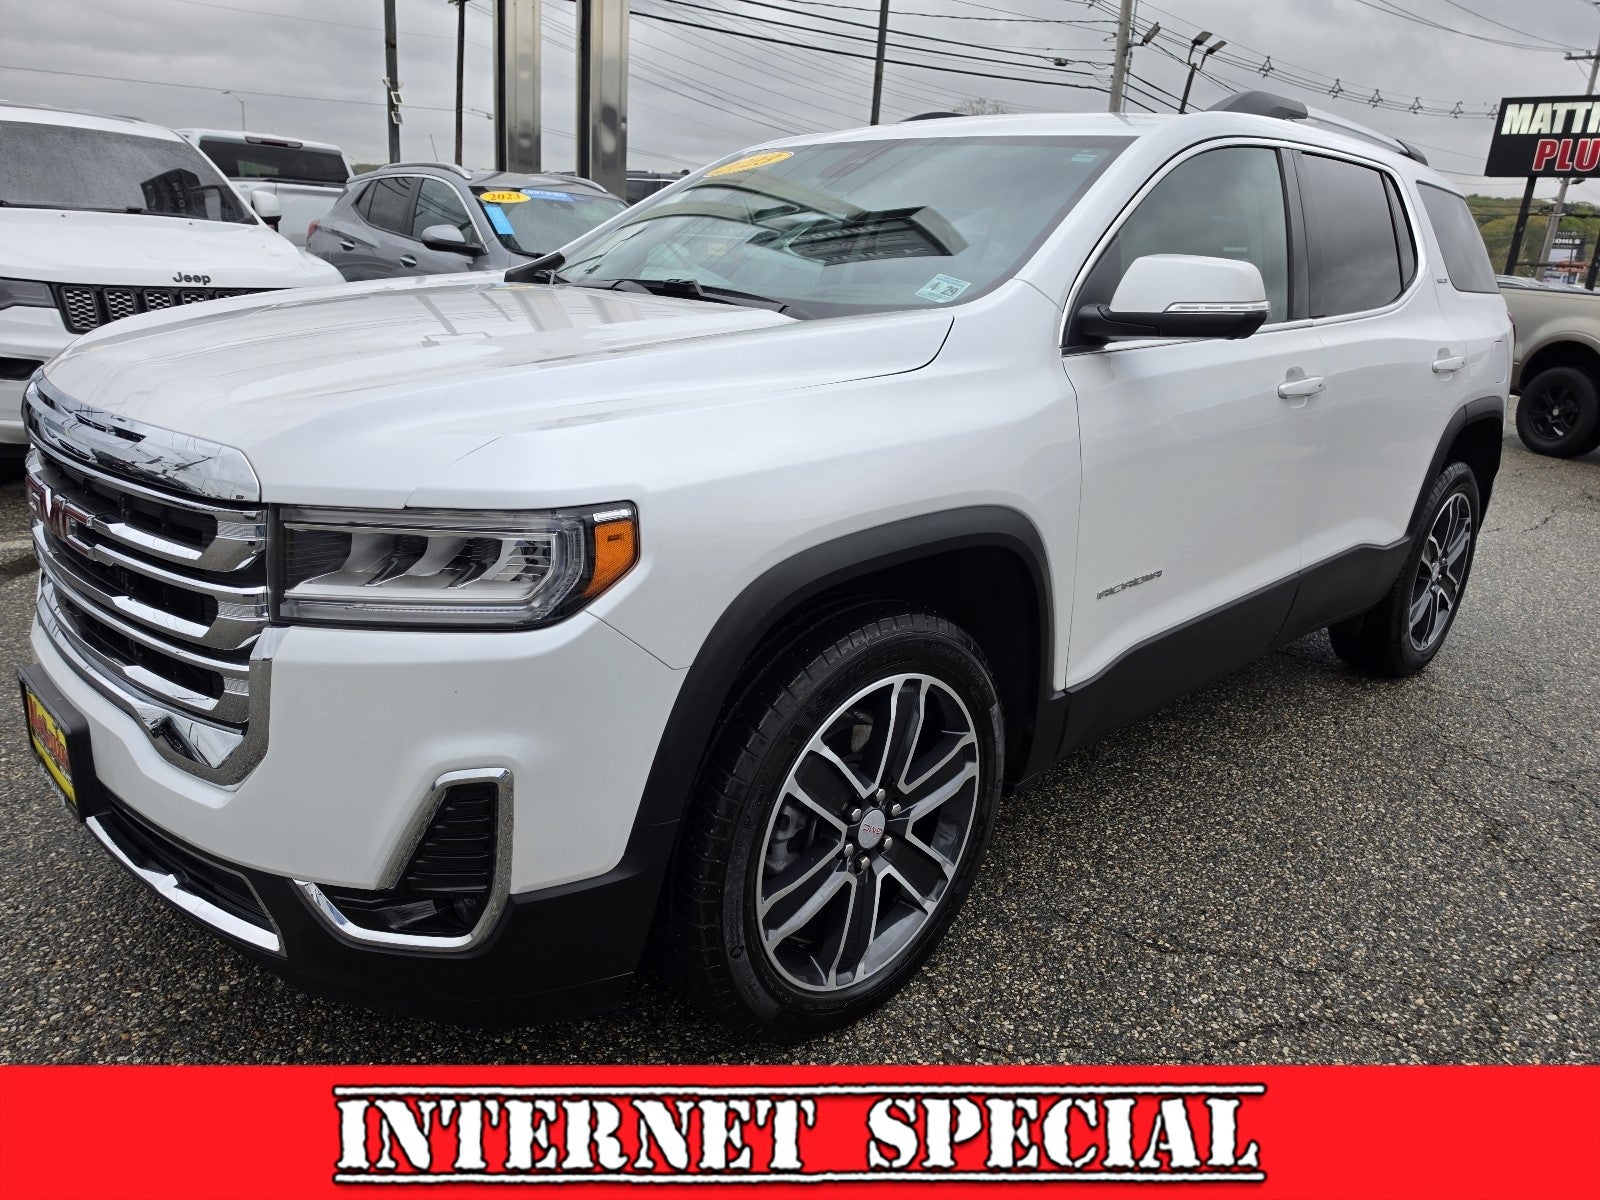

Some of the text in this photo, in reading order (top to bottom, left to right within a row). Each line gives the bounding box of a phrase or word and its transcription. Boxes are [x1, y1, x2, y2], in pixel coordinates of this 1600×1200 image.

[172, 271, 211, 285] Jeep
[1097, 569, 1162, 600] ACADIA
[863, 823, 882, 836] GMC
